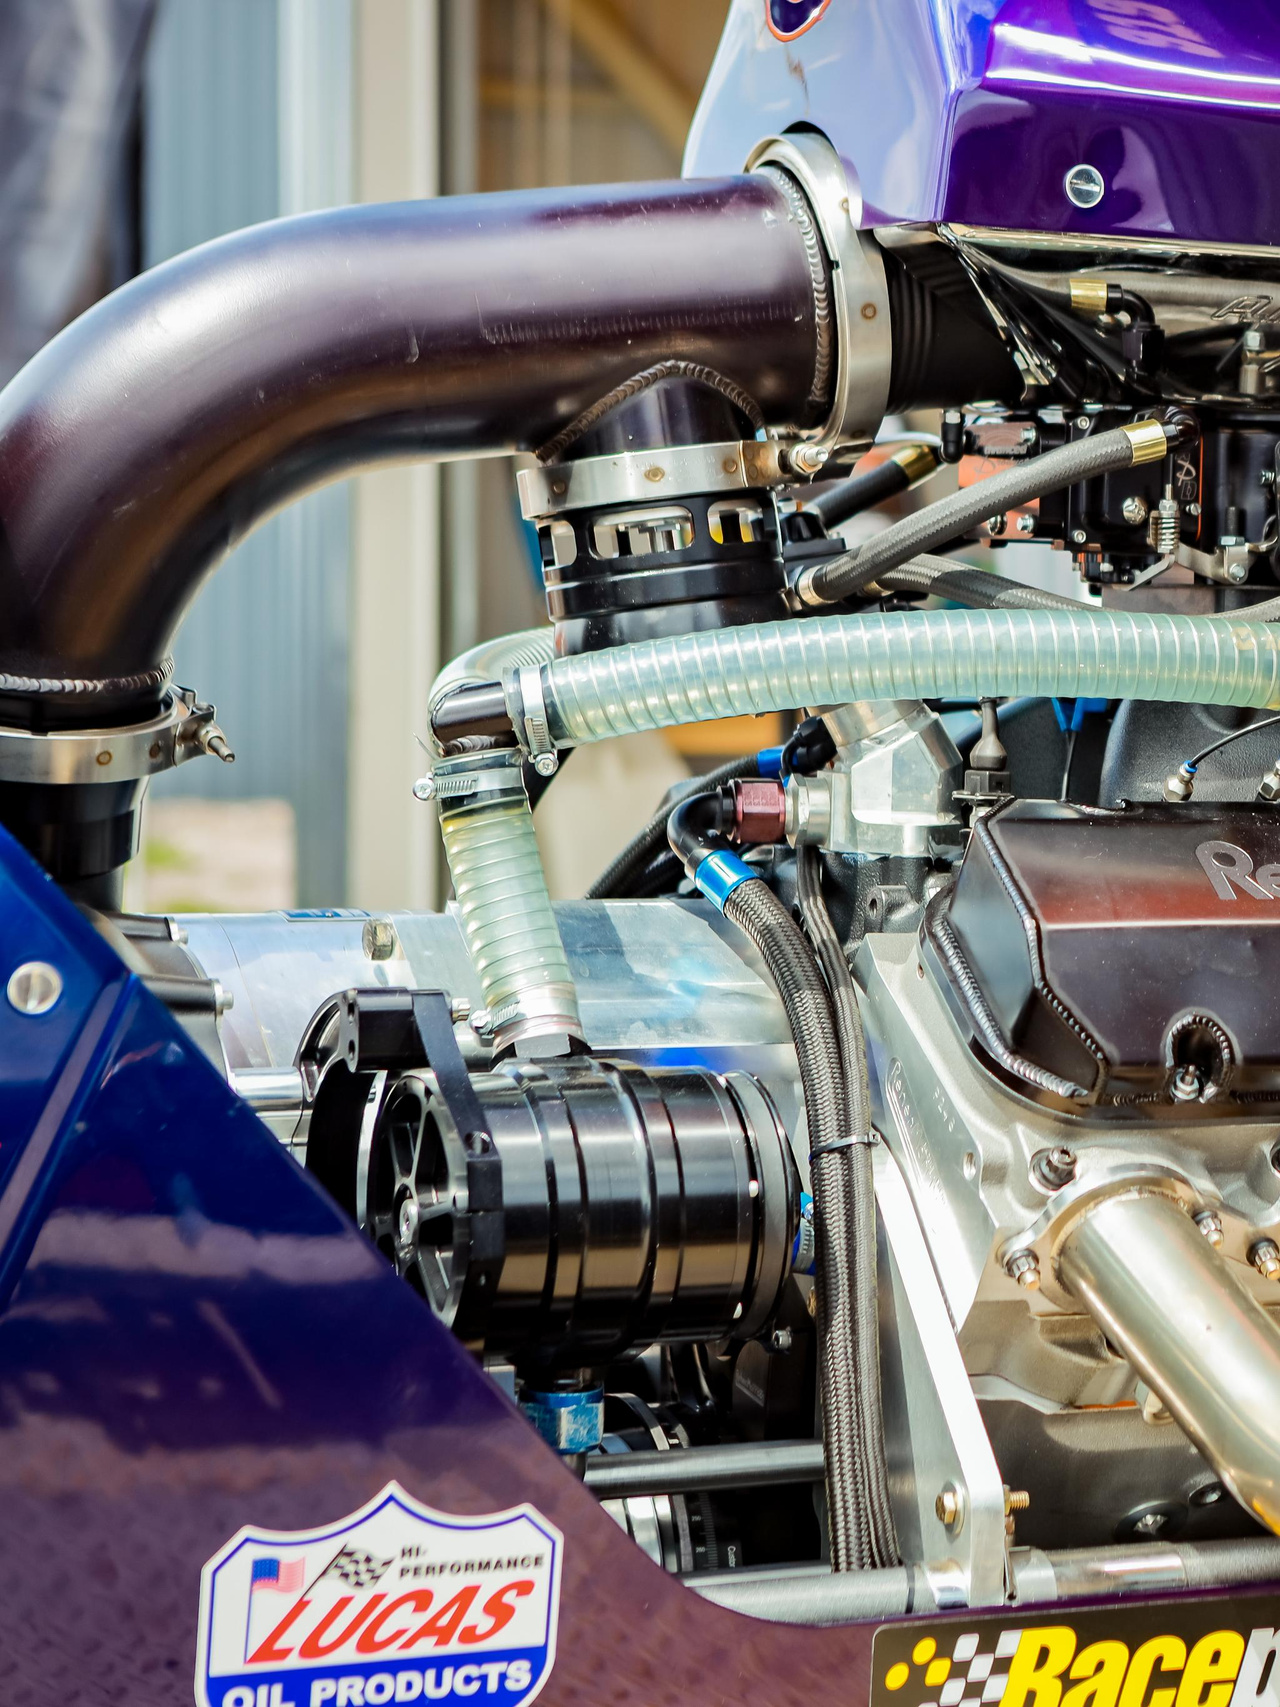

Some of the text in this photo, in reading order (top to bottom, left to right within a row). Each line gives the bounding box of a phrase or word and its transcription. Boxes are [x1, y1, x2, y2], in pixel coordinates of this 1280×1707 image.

[400, 1553, 545, 1579] PERFORMANCE
[401, 1544, 428, 1559] HI-
[244, 1579, 536, 1664] LUCAS
[222, 1659, 533, 1707] OIL PRODUCTS
